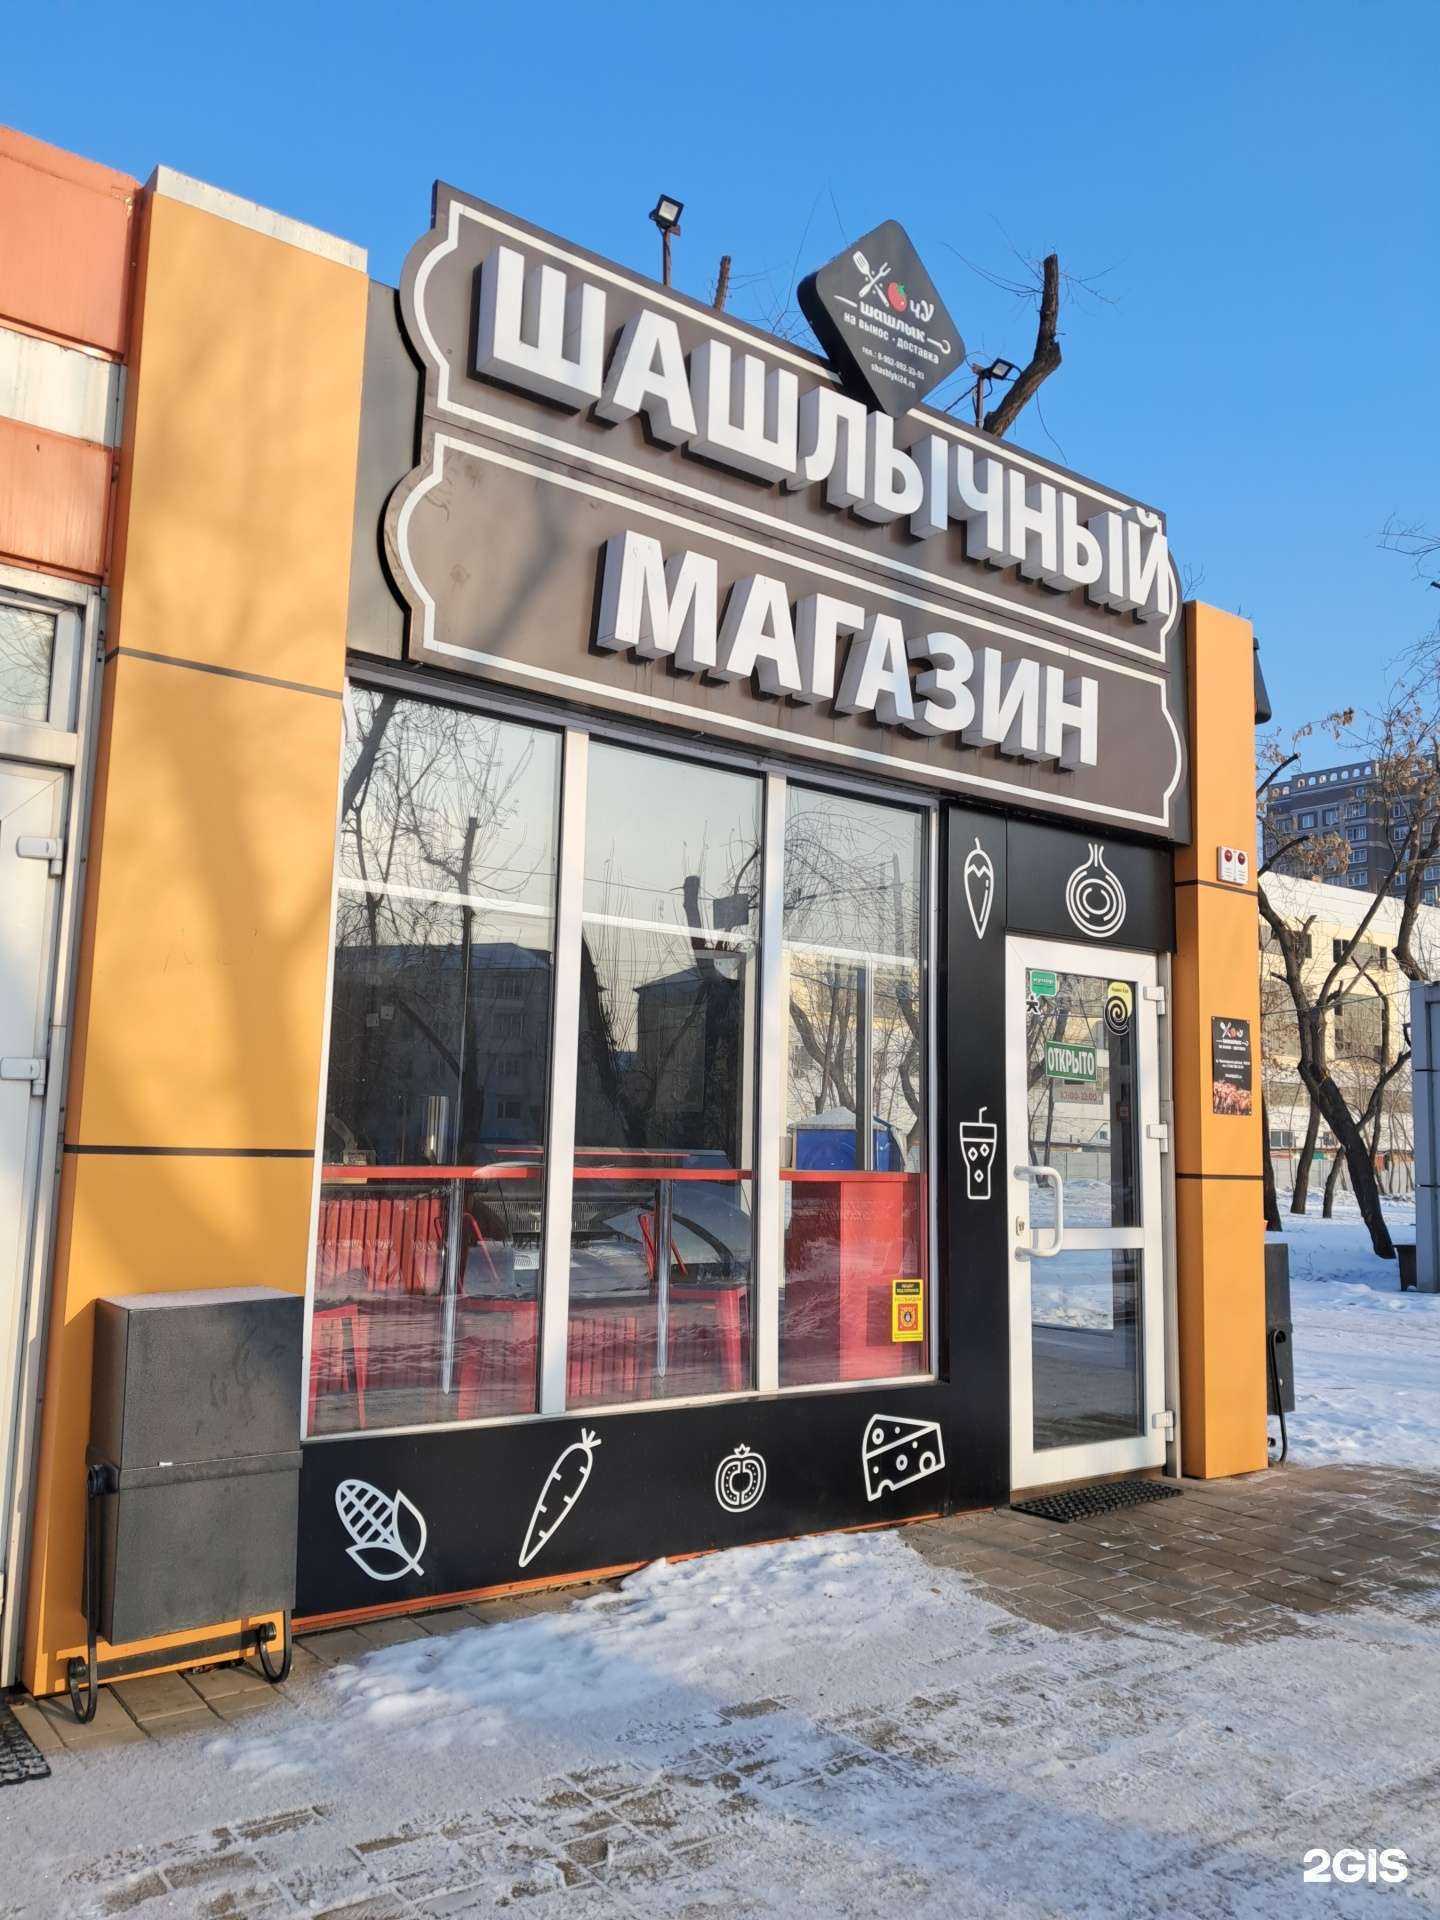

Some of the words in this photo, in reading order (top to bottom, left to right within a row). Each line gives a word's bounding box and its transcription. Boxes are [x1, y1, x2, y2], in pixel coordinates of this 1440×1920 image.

[843, 312, 856, 325] на
[858, 319, 889, 340] вынос
[897, 337, 939, 364] доставка
[860, 301, 926, 342] шашлык
[478, 246, 1171, 623] ШАШЛЫЧНЫЙ
[602, 530, 1098, 770] МАГАЗИН
[1047, 1047, 1095, 1076] ОТКРЫТО
